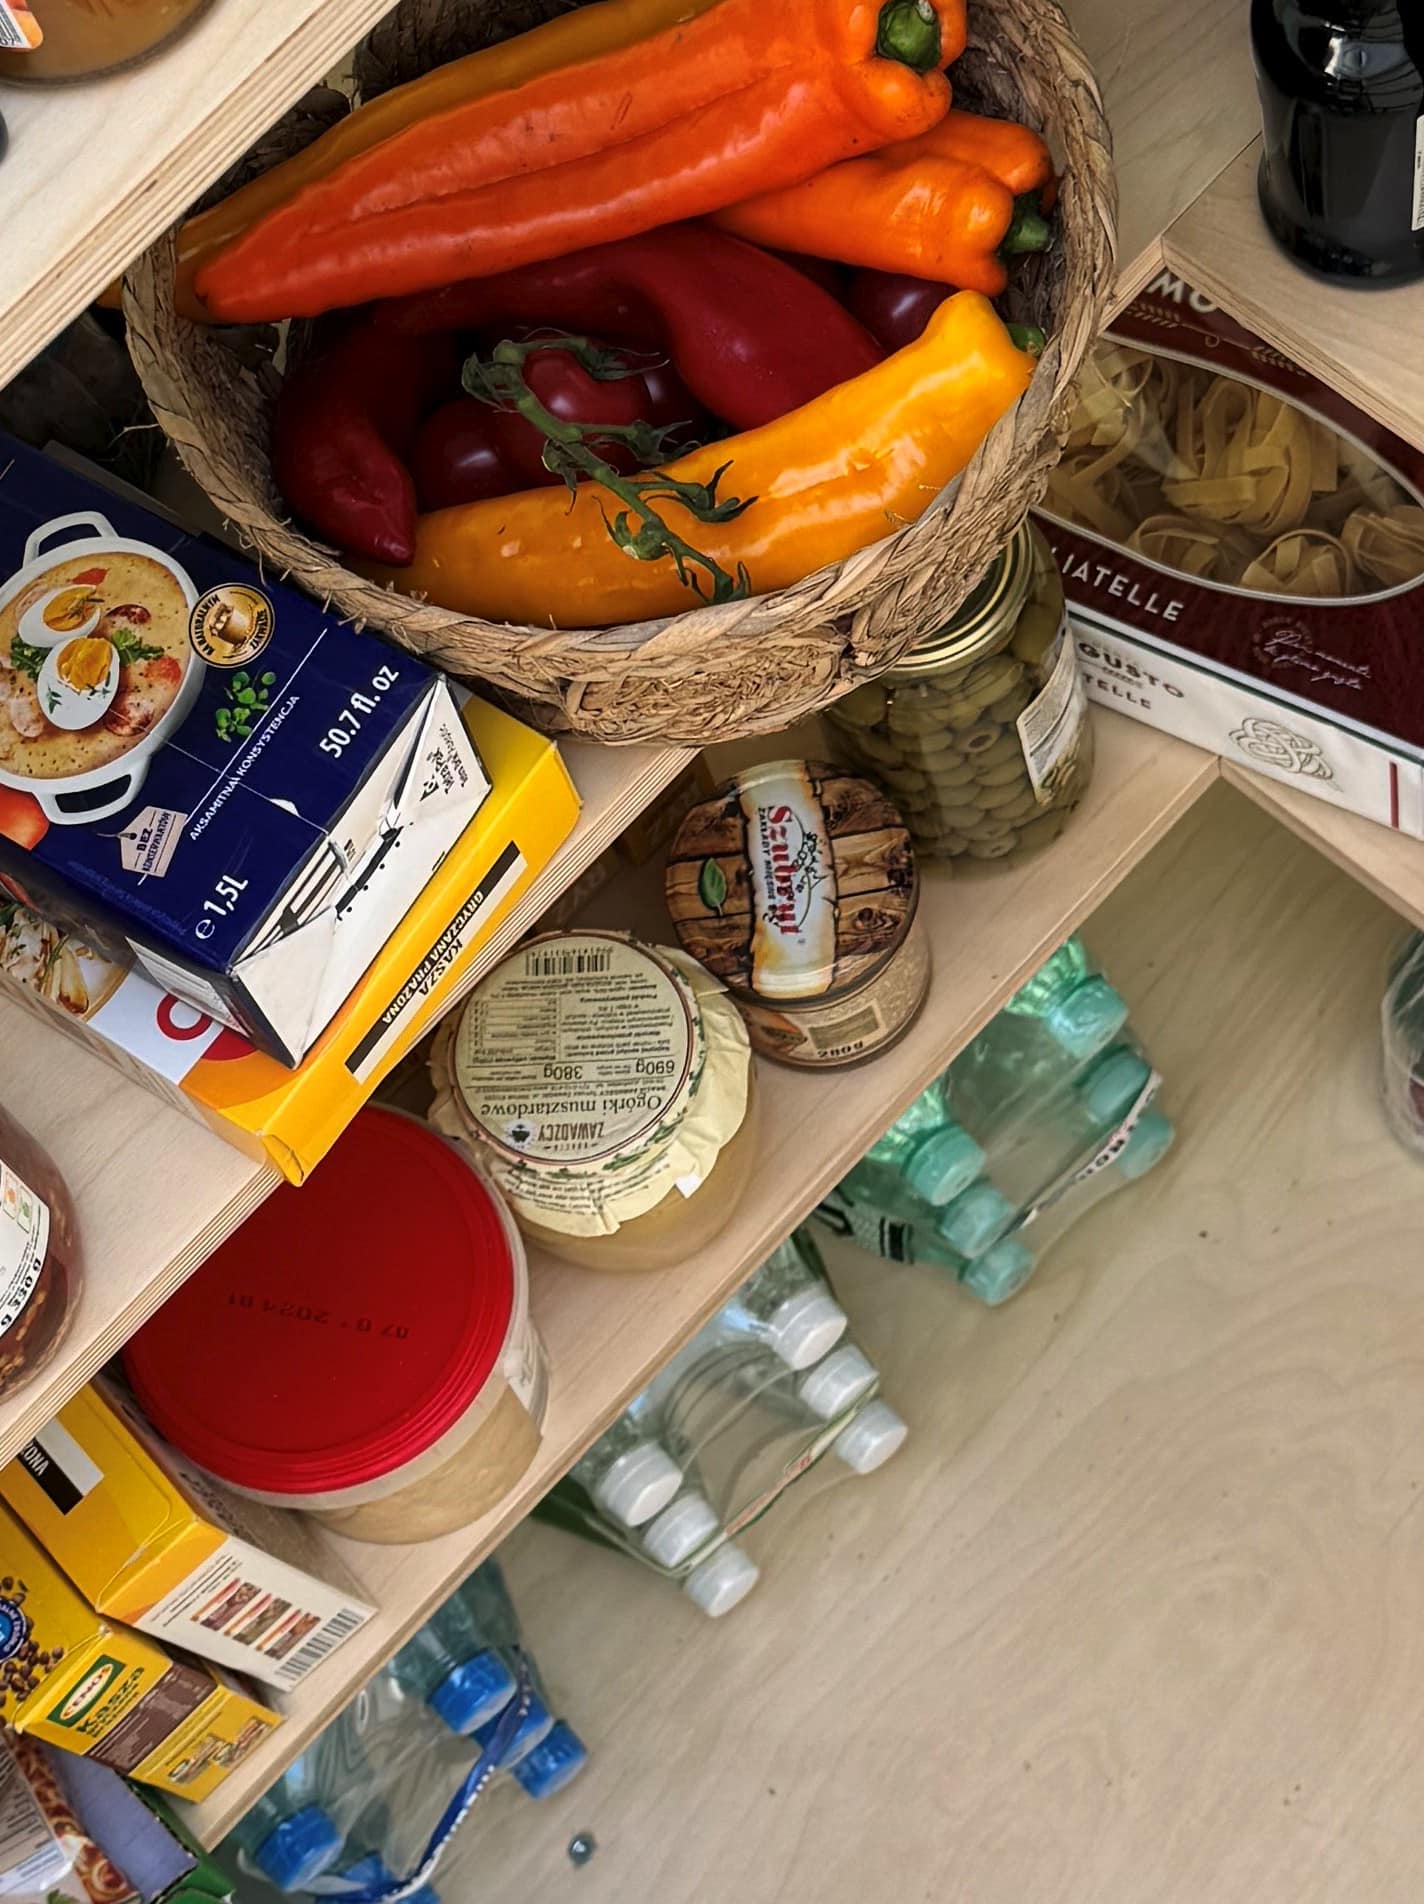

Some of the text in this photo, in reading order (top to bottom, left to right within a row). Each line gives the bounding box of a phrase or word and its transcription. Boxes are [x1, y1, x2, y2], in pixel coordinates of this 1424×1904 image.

[1077, 641, 1186, 699] GUSTO
[319, 664, 400, 759] 50.7 oz
[188, 695, 301, 841] AKSAMITNA KONSYSTENCJA
[202, 872, 250, 918] 1,5L
[429, 889, 485, 965] GRYCZANA
[418, 938, 465, 998] KASZA
[543, 1058, 675, 1081] 380g 690g
[480, 1095, 662, 1118] Ogórki musztardowe
